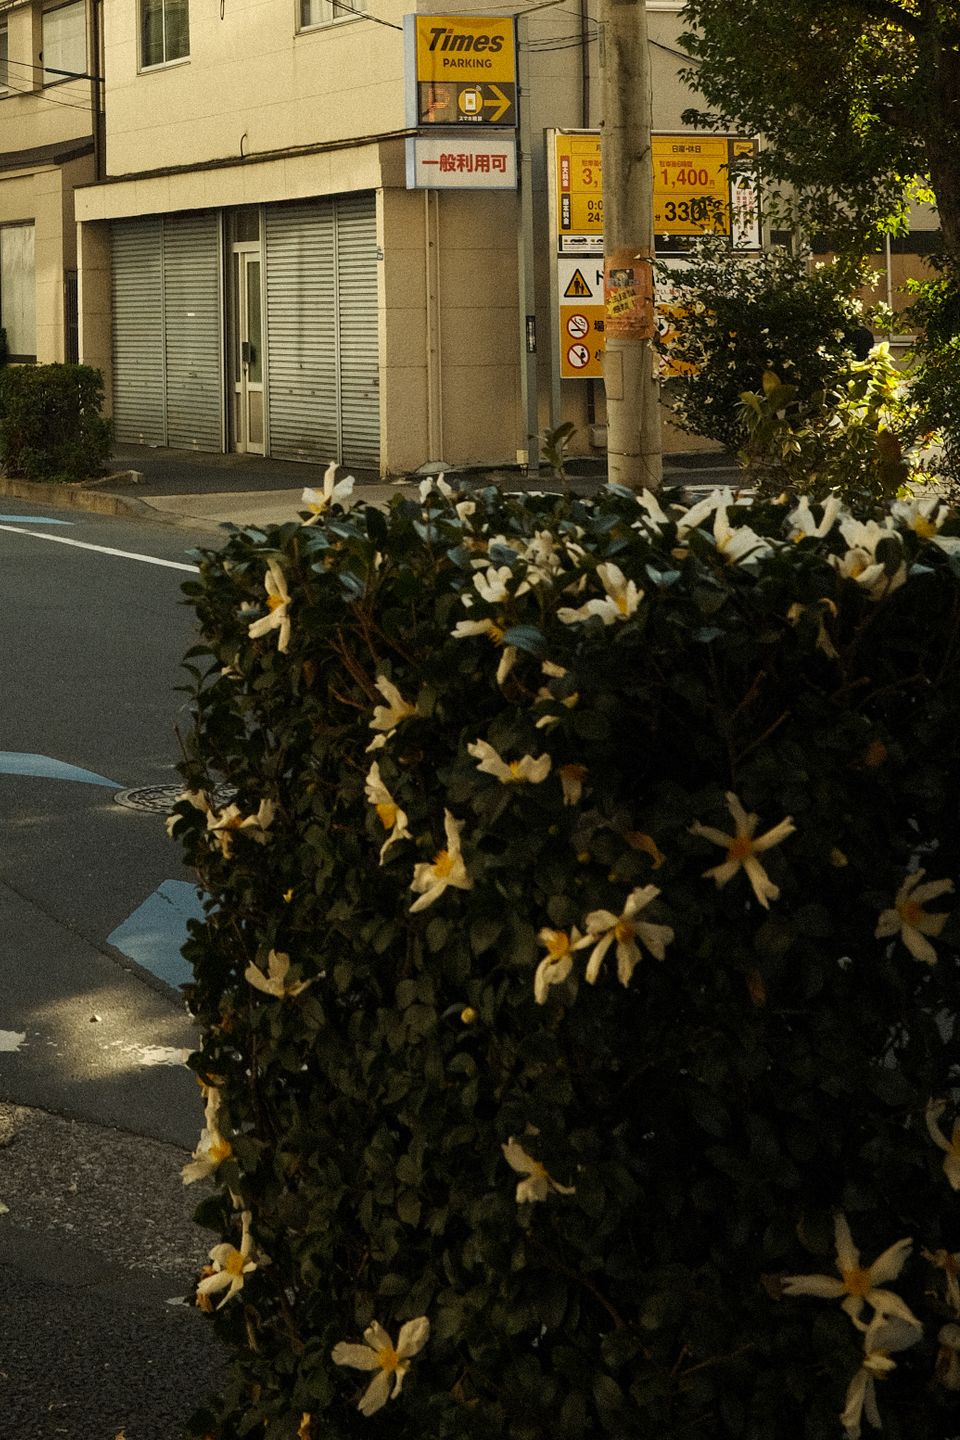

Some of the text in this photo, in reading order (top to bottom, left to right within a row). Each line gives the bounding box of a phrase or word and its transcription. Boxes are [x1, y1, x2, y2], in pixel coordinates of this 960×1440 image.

[429, 27, 505, 53] Times
[442, 58, 493, 69] PARKING
[422, 153, 508, 173] 一般利用可
